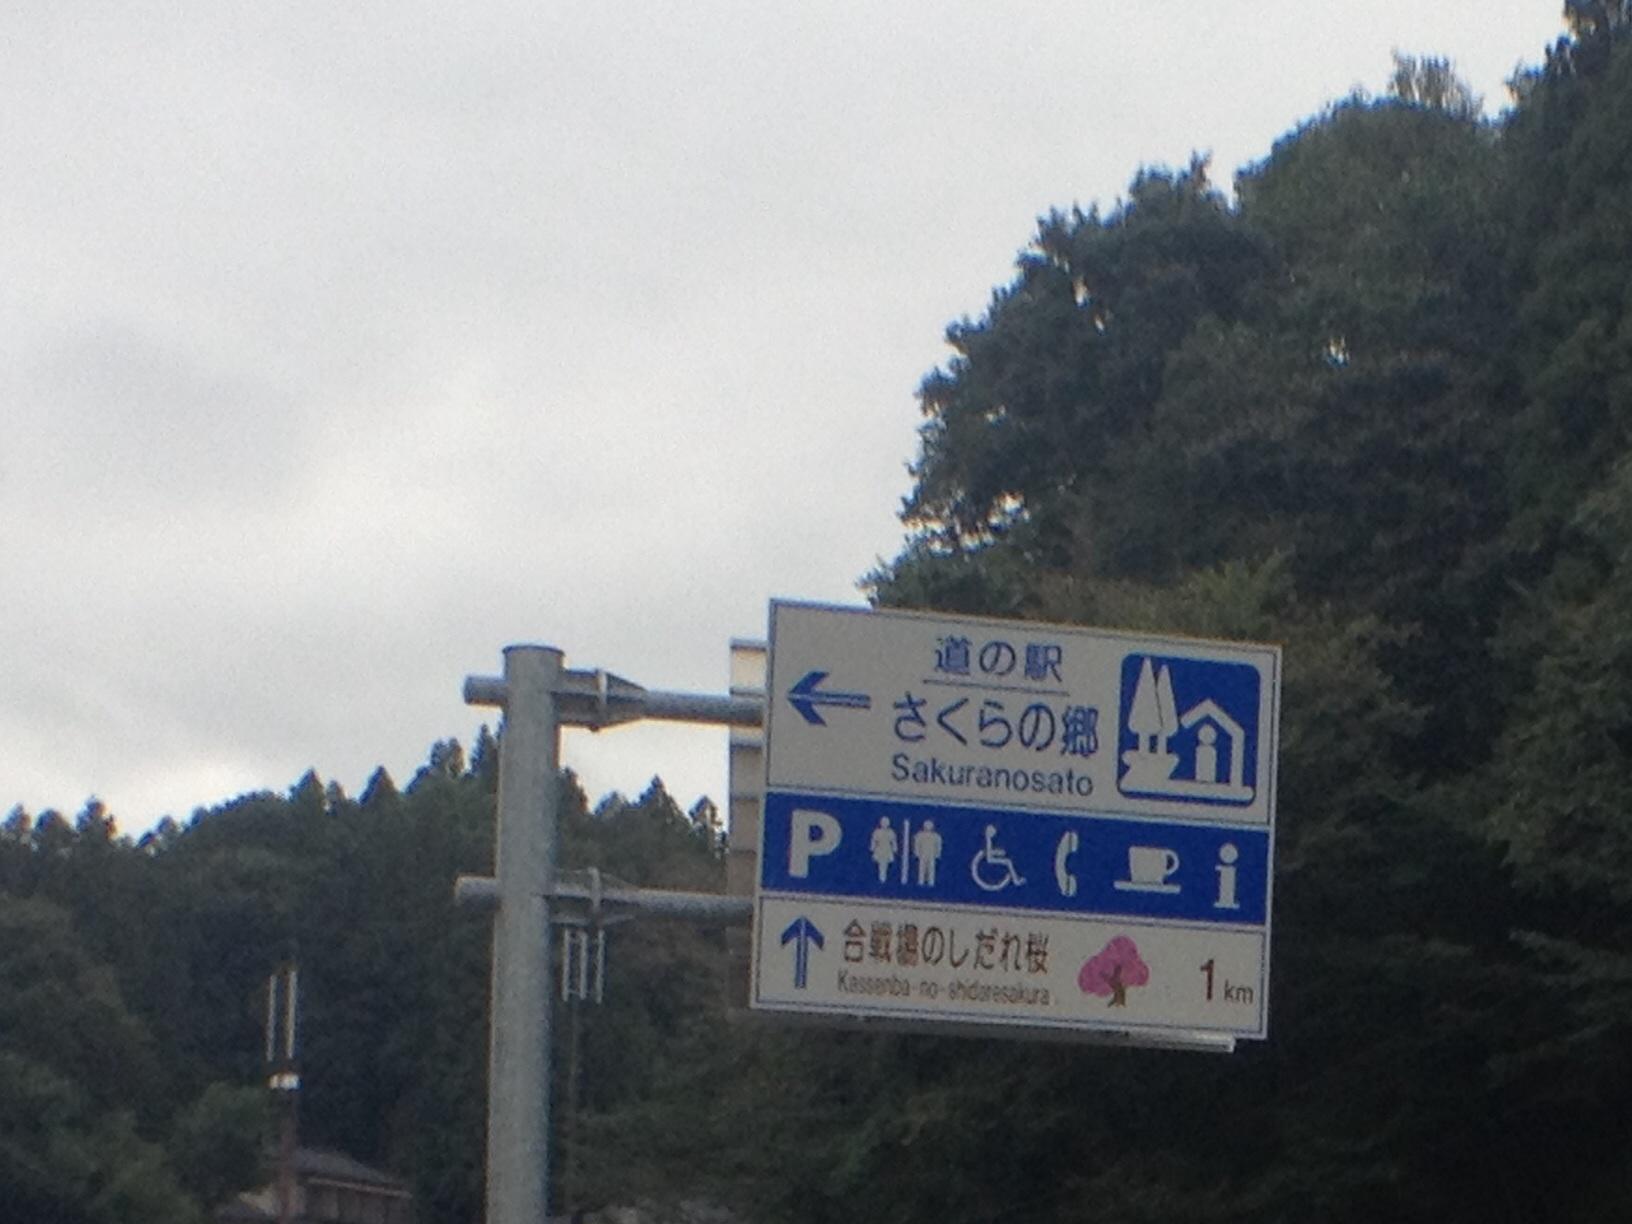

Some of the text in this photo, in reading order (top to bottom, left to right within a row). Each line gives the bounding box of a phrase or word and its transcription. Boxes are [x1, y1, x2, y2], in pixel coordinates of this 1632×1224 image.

[935, 635, 1063, 683] 道の駅
[893, 692, 1099, 758] さくらの郷
[891, 753, 1094, 797] Sakuranosato
[789, 808, 843, 878] P
